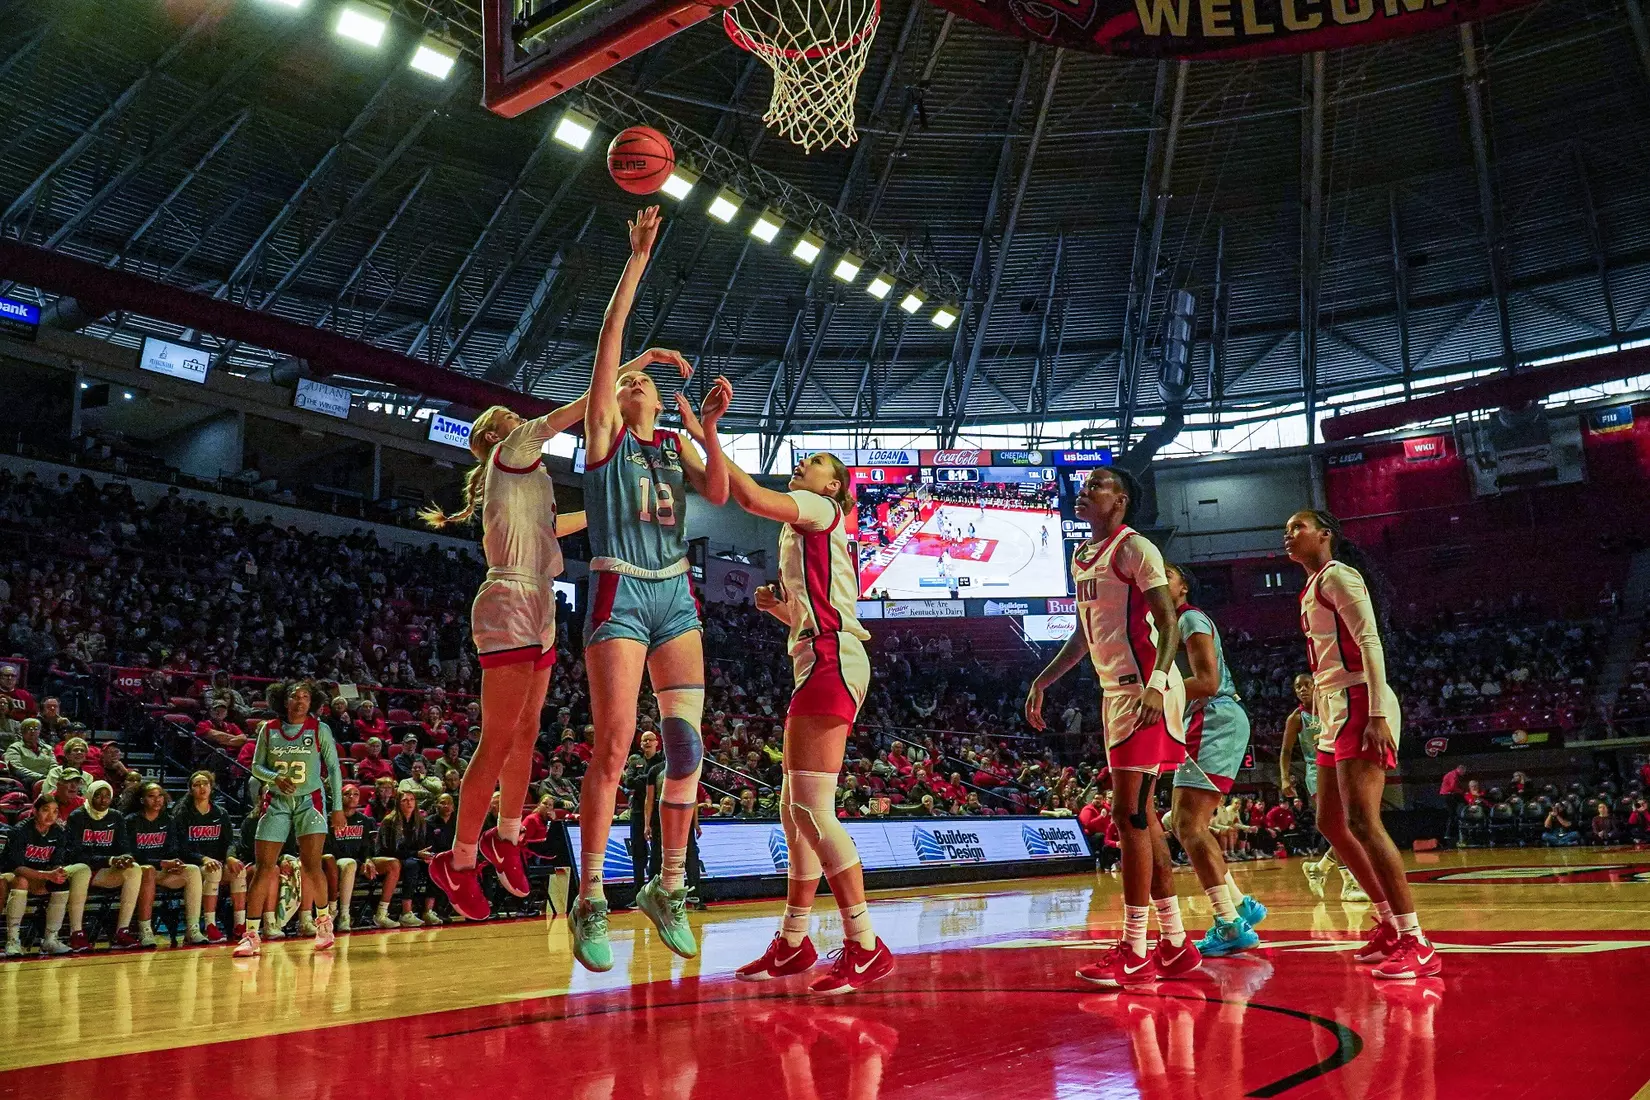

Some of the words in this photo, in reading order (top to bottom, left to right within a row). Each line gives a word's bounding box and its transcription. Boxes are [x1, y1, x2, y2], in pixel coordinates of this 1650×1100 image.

[613, 160, 646, 170] ELITE
[0, 302, 28, 317] ank
[1602, 413, 1618, 423] FIU
[433, 417, 470, 438] ATMO
[444, 433, 469, 447] energ
[1000, 451, 1029, 459] CHEETAH
[1414, 443, 1435, 453] WKU
[868, 451, 898, 460] LOGAN
[933, 450, 979, 466] Coca-Cola
[887, 604, 909, 614] Prairie
[923, 600, 936, 608] We
[937, 600, 949, 608] Are
[998, 602, 1028, 610] Builders
[1048, 600, 1077, 614] Bud
[909, 608, 944, 617] Kentucky's
[945, 607, 964, 616] Dairy
[1004, 608, 1029, 616] Design
[1046, 622, 1075, 631] Kentucky
[119, 677, 142, 686] 105
[1244, 754, 1253, 768] 2
[274, 761, 306, 784] 23
[82, 829, 114, 843] WKU
[189, 824, 221, 838] WKU
[934, 829, 979, 845] Builders
[1038, 827, 1076, 841] Builders
[136, 832, 167, 846] WKU
[25, 844, 55, 860] WKU
[947, 845, 985, 862] Design
[1050, 840, 1082, 856] Design
